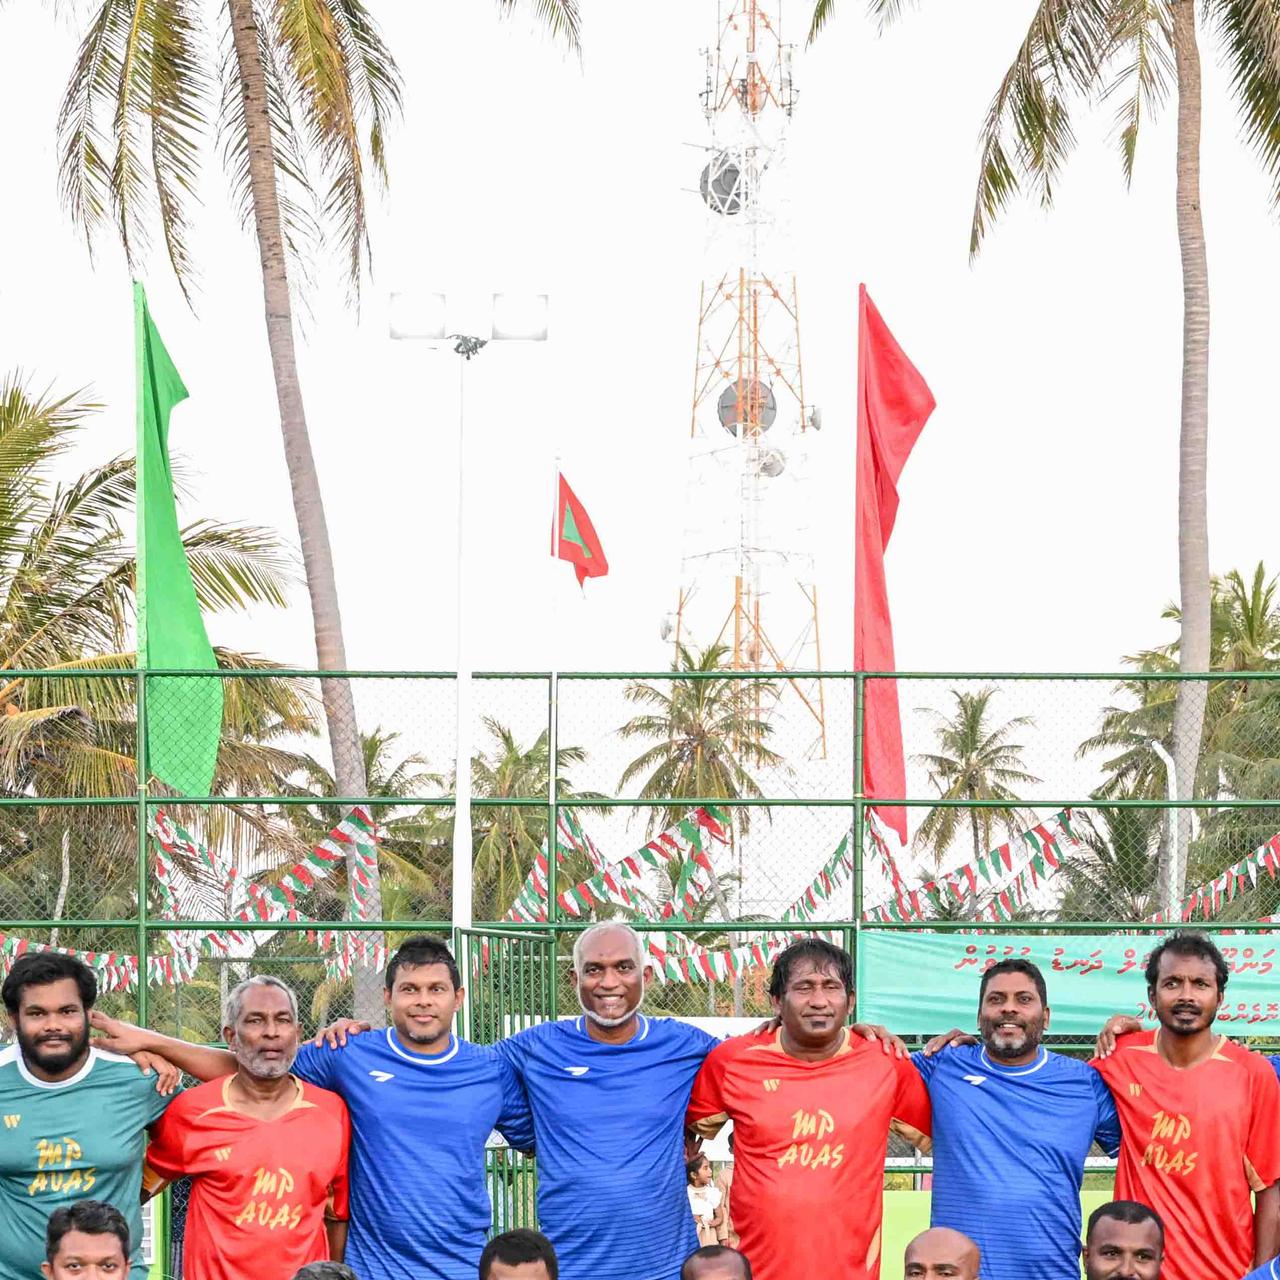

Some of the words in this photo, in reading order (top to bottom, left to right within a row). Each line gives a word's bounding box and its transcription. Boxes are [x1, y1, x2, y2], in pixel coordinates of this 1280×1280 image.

[791, 1108, 834, 1141] MP
[1151, 1110, 1191, 1146] MP
[35, 1137, 82, 1169] MP
[251, 1167, 295, 1200] MP
